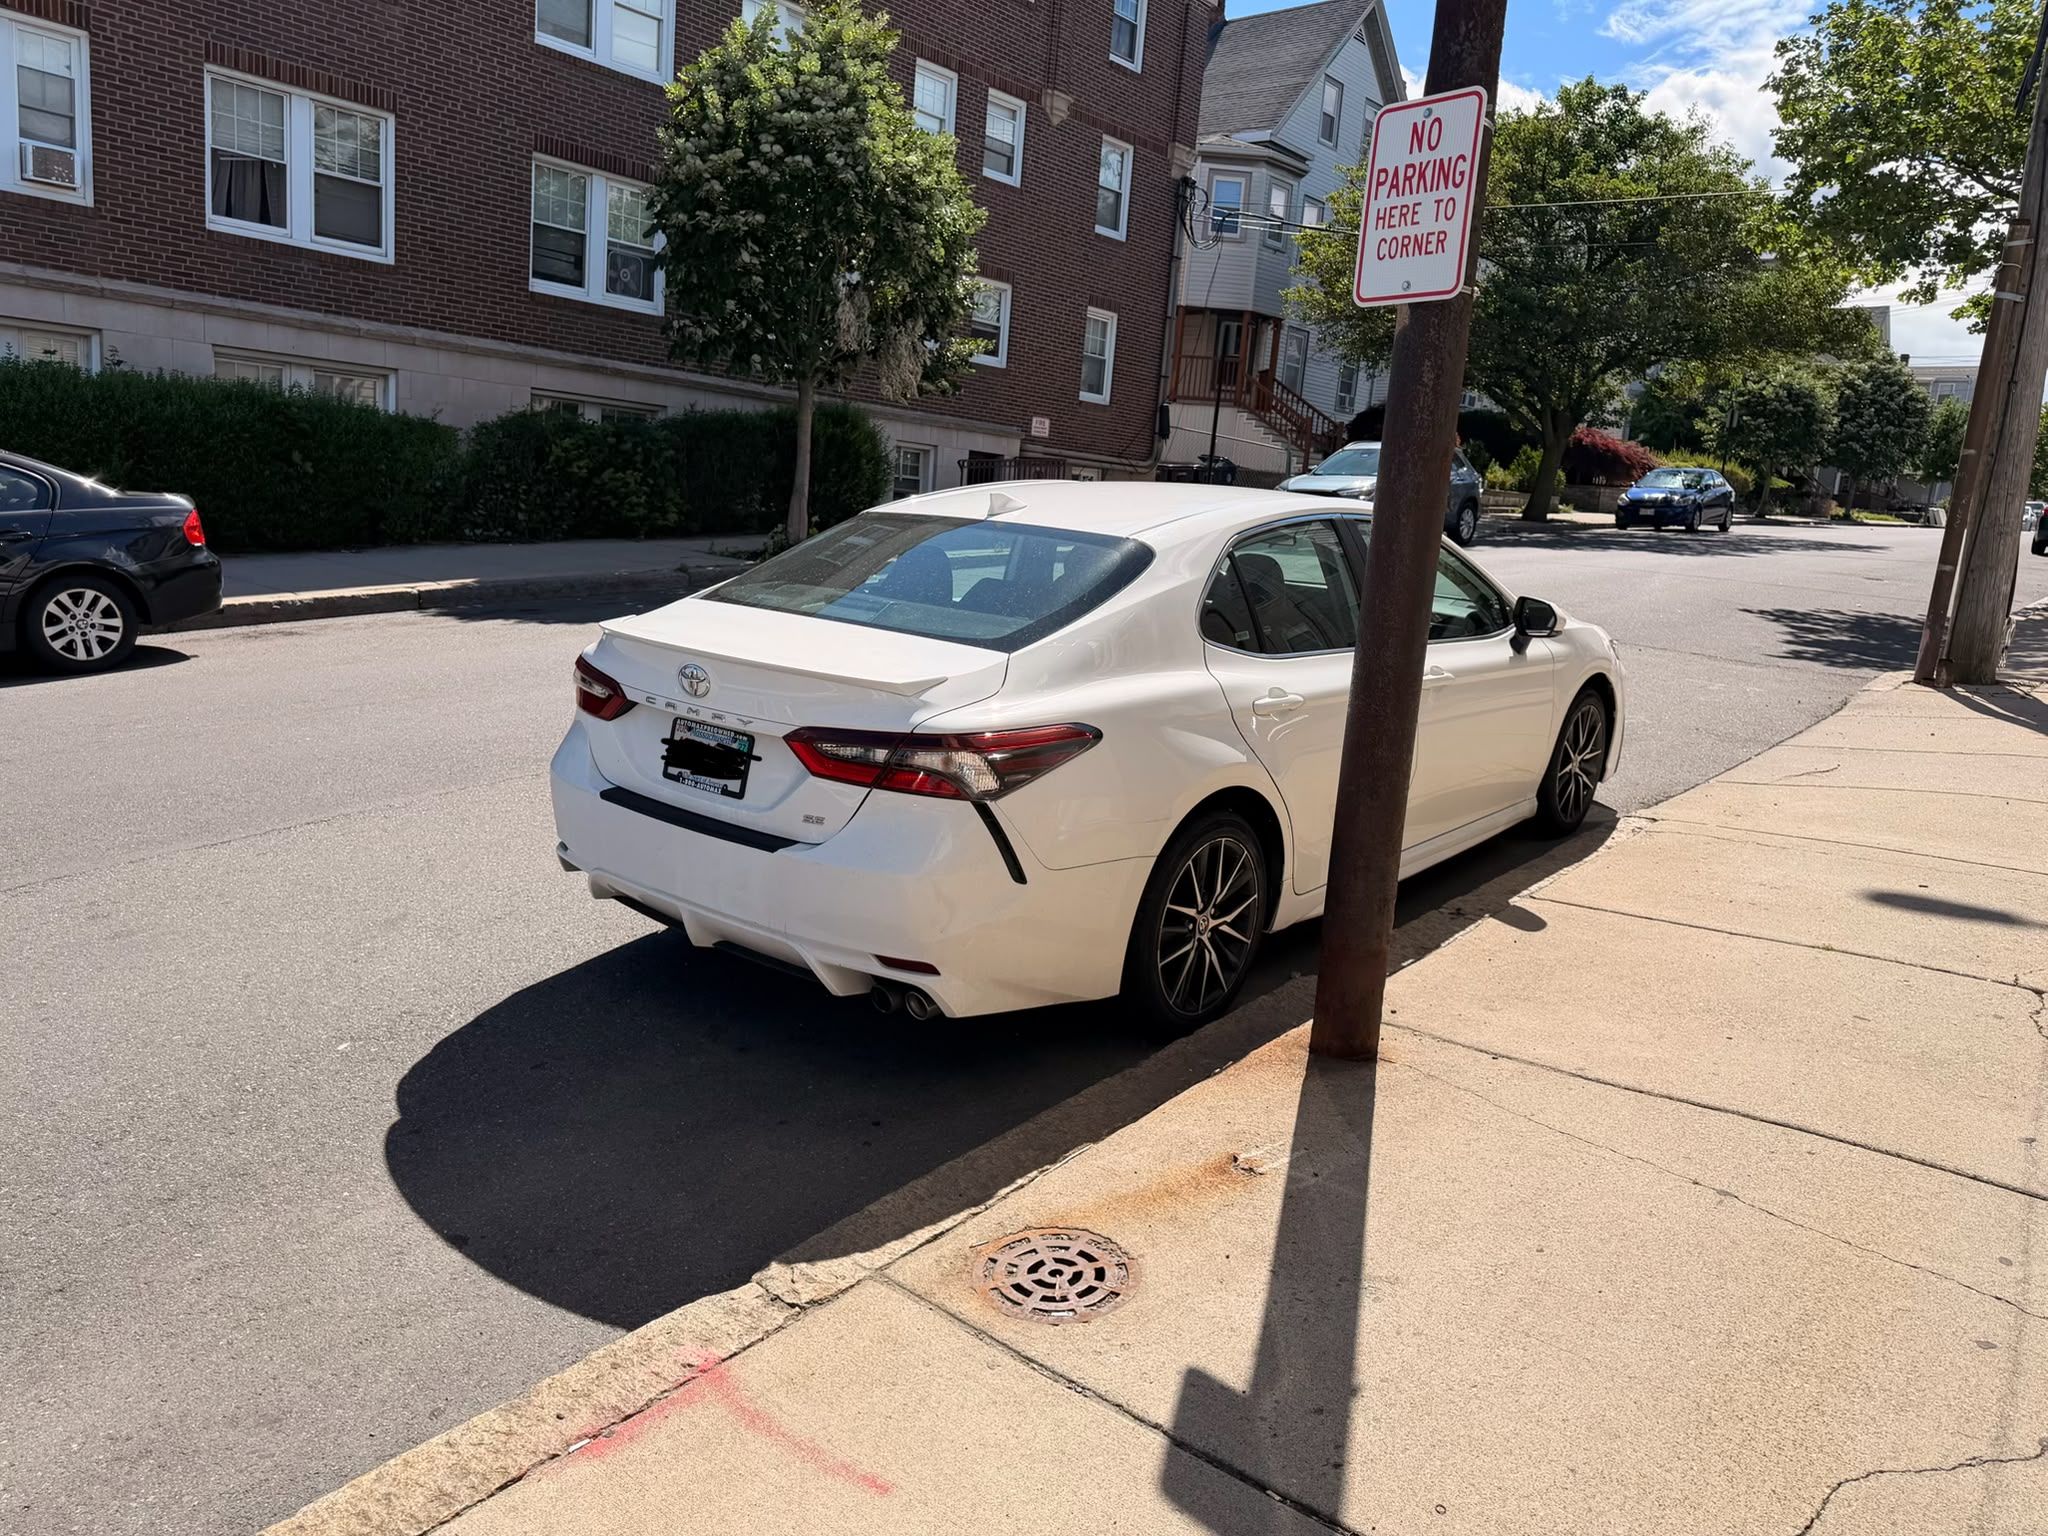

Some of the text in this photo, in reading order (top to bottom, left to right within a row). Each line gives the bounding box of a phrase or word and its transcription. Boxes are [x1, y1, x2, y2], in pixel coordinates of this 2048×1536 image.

[1409, 117, 1443, 155] NO
[1374, 154, 1467, 200] PARKING
[1375, 197, 1456, 231] HERE TO
[1377, 230, 1447, 261] CORNER
[646, 696, 753, 727] CAMRY
